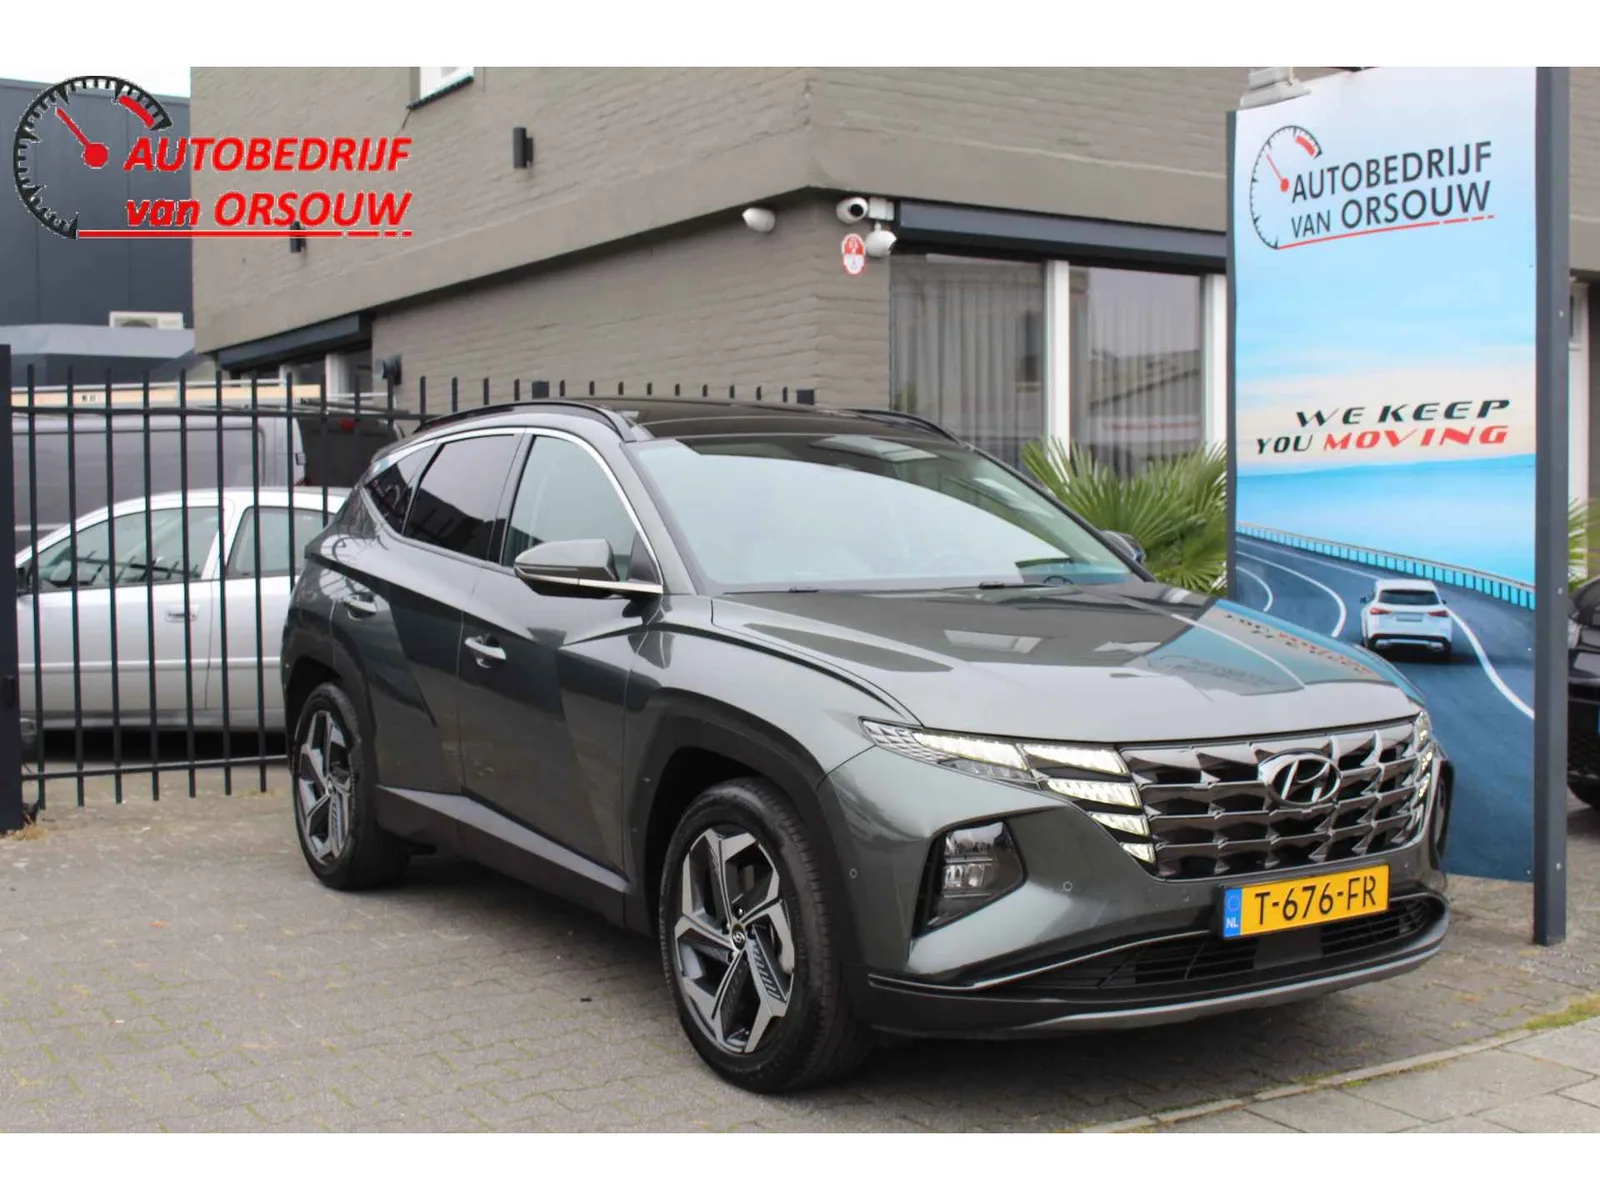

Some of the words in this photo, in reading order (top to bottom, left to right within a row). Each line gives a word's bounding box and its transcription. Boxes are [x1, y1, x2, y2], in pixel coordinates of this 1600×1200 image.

[1291, 141, 1492, 203] AUTOBEDRIJF
[1291, 210, 1331, 239] VAN
[1341, 180, 1491, 229] ORSOUW
[1296, 407, 1365, 428] WE
[1378, 399, 1510, 423] KEEP
[1256, 434, 1313, 455] YOU
[1323, 425, 1508, 450] MOVING
[1255, 875, 1376, 925] T-676-FR
[1226, 917, 1239, 928] NL
